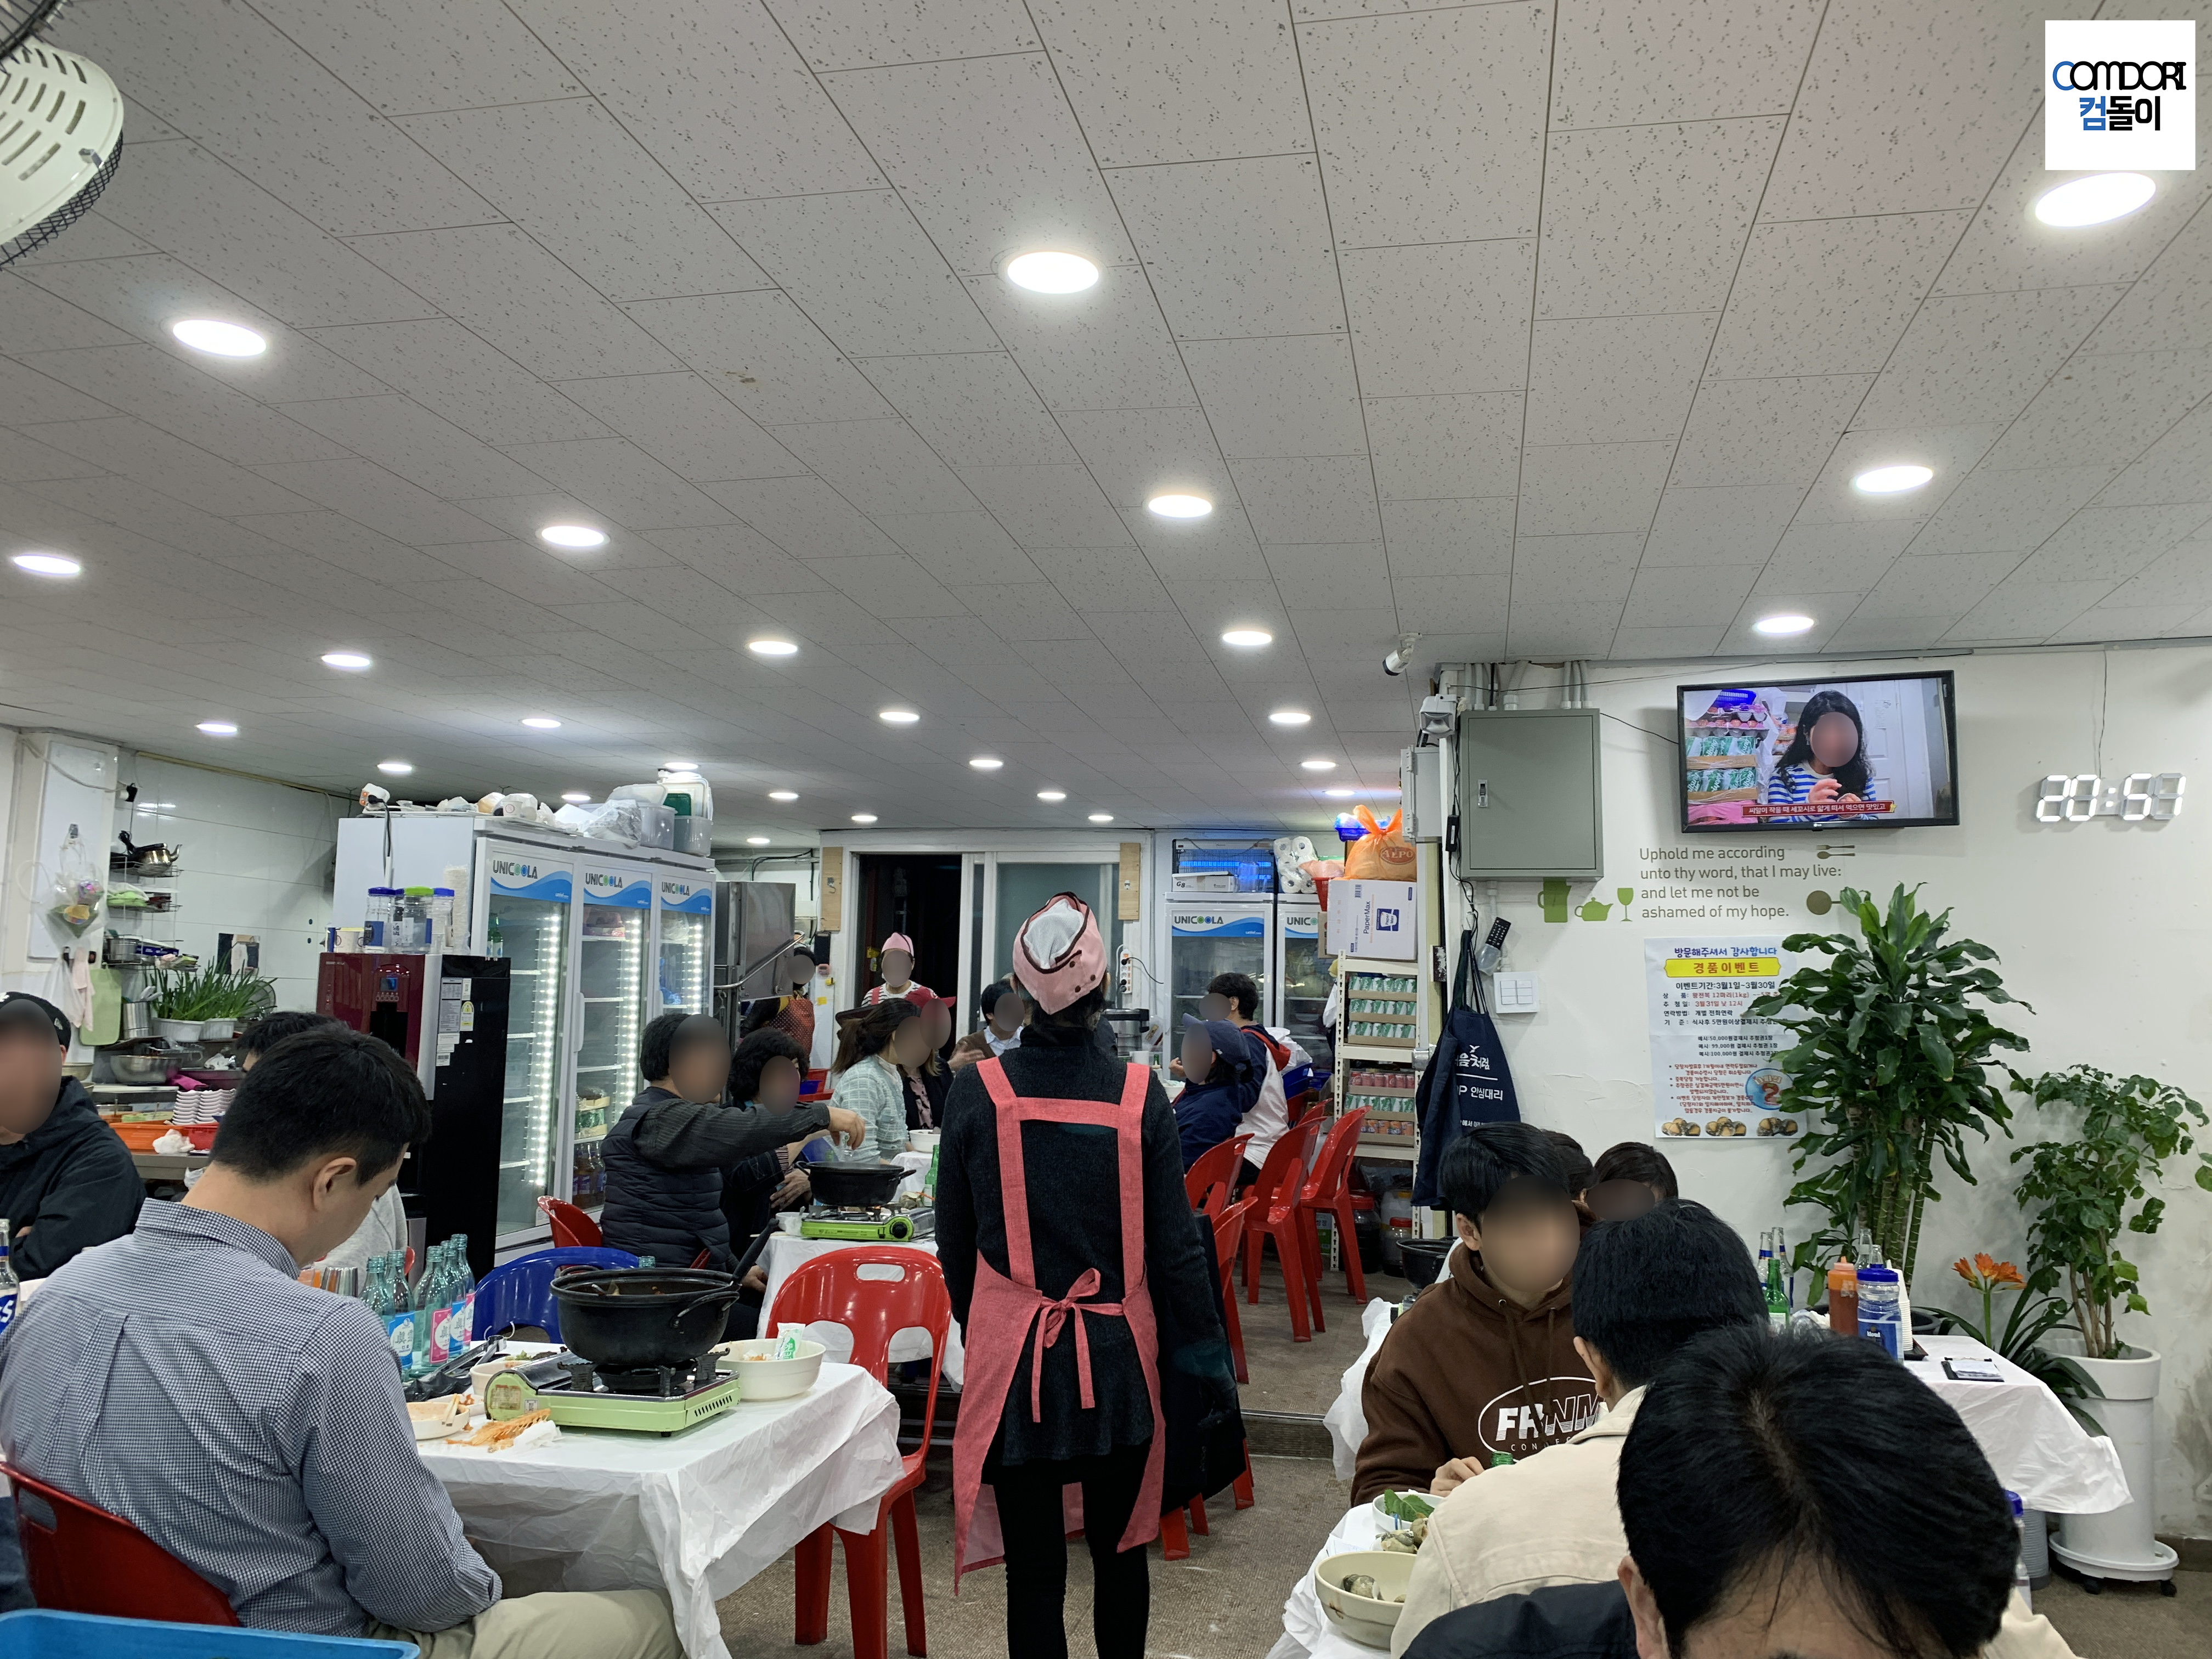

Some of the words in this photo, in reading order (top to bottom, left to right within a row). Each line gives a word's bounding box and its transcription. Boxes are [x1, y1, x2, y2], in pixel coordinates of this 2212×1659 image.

[1639, 847, 1689, 863] Uphold
[1692, 850, 1714, 859] me
[1718, 845, 1785, 860] according
[493, 860, 538, 879] UNICOOLA
[1640, 868, 1671, 879] unto
[1674, 867, 1695, 882] thy
[1699, 866, 1737, 880] word,
[1740, 866, 1768, 878] that
[1773, 865, 1776, 877] I
[1779, 867, 1809, 881] may
[1812, 864, 1842, 877] live:
[585, 872, 623, 888] UNICOOLA
[662, 881, 690, 896] UNICOOLA
[1641, 886, 1667, 899] and
[1671, 886, 1687, 898] let
[1691, 888, 1713, 899] me
[1717, 887, 1739, 898] not
[1743, 885, 1759, 898] be
[1175, 916, 1224, 924] UNICOOLA
[1641, 906, 1705, 918] ashamed
[1709, 905, 1723, 918] of
[1726, 907, 1746, 920] my
[1751, 905, 1789, 920] hope.
[1674, 947, 1728, 958] 방문해주셔서
[1730, 946, 1777, 957] 감사합니다
[1470, 1086, 1503, 1101] 안심대리
[0, 1299, 14, 1323] S
